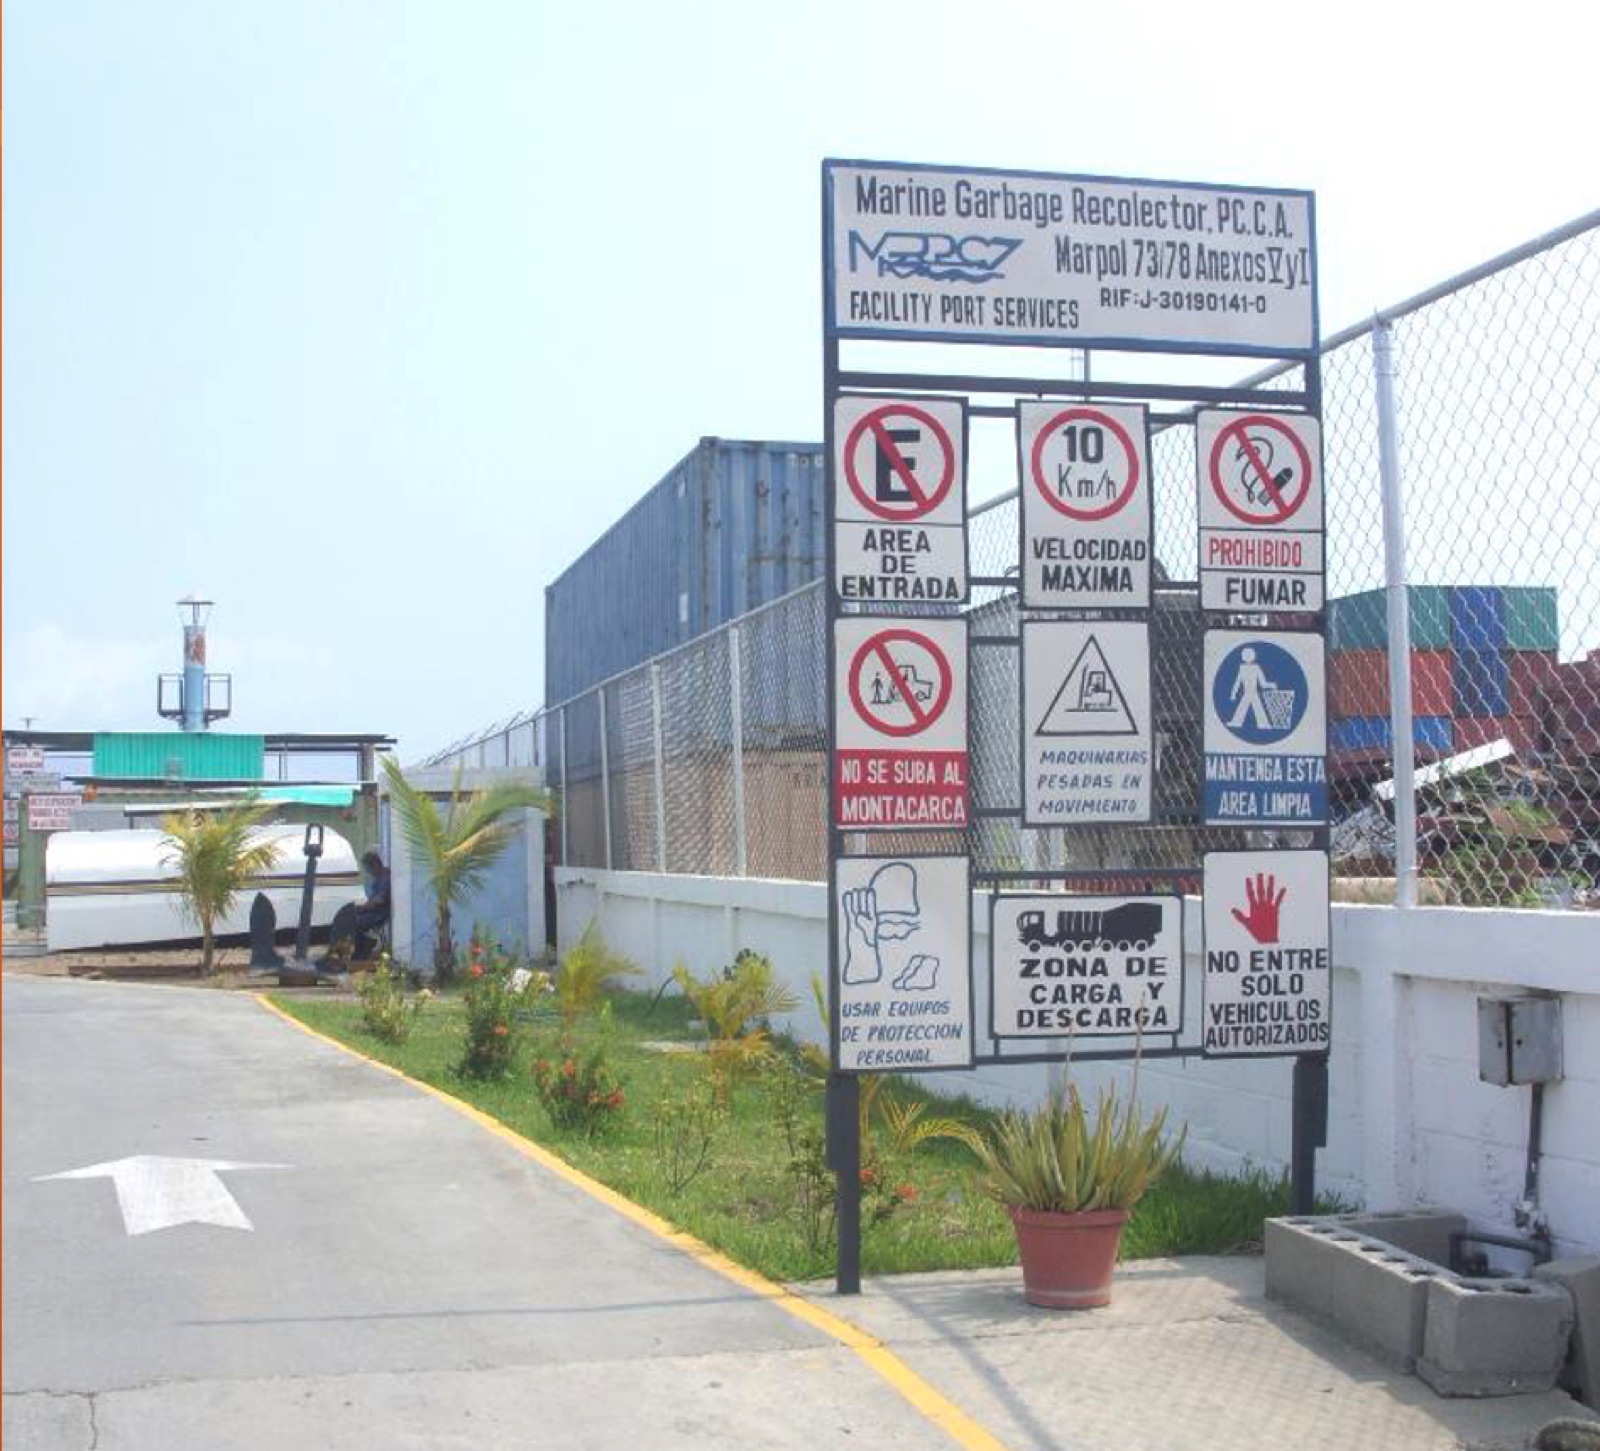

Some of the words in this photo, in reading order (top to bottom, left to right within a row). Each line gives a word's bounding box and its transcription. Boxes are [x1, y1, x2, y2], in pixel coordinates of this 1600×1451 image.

[856, 175, 946, 216] Marine
[955, 180, 1063, 228] Garbage
[1055, 234, 1127, 281] Marpol
[1195, 242, 1266, 282] Anexos
[850, 290, 932, 323] FACILITY
[941, 295, 986, 324] PORT
[994, 297, 1079, 329] SERVICES
[1062, 425, 1104, 464] 10
[863, 528, 931, 553] AREA
[1033, 538, 1146, 561] VELOCIDAD
[1208, 538, 1302, 567] PROHIBIDO
[881, 554, 916, 574] DE
[841, 575, 960, 600] ENTRADA
[1041, 565, 1134, 593] MAXIMA
[1226, 578, 1306, 605] FUMAR
[1040, 750, 1147, 765] MAQUINARIAS
[1205, 755, 1283, 782] MANTENGA
[1287, 757, 1326, 783] ESTA
[841, 758, 860, 784] NO
[867, 758, 888, 784] SE
[894, 759, 936, 784] SUBA
[943, 760, 964, 785] AL
[1037, 773, 1112, 790] PESADAS
[1121, 774, 1142, 789] EN
[1038, 799, 1138, 814] MOVIMIENTO
[1218, 791, 1257, 816] AREA
[1262, 791, 1312, 817] LIMPIA
[1019, 957, 1109, 978] ZONA
[1126, 957, 1168, 977] DE
[1207, 950, 1239, 973] NO
[1250, 948, 1328, 972] ENTRE
[1030, 982, 1123, 1004] CARGA
[1147, 982, 1165, 1000] Y
[1241, 973, 1304, 996] SOLO
[842, 1001, 881, 1018] USAR
[888, 1001, 951, 1017] EQUIPOS
[1017, 1005, 1168, 1028] DESCARGA
[1209, 999, 1320, 1025] VEHICULOS
[842, 1026, 860, 1042] DE
[867, 1021, 963, 1042] PROTECCION
[1206, 1022, 1329, 1048] AUTORIZADOS
[857, 1048, 934, 1066] PERSONAL
